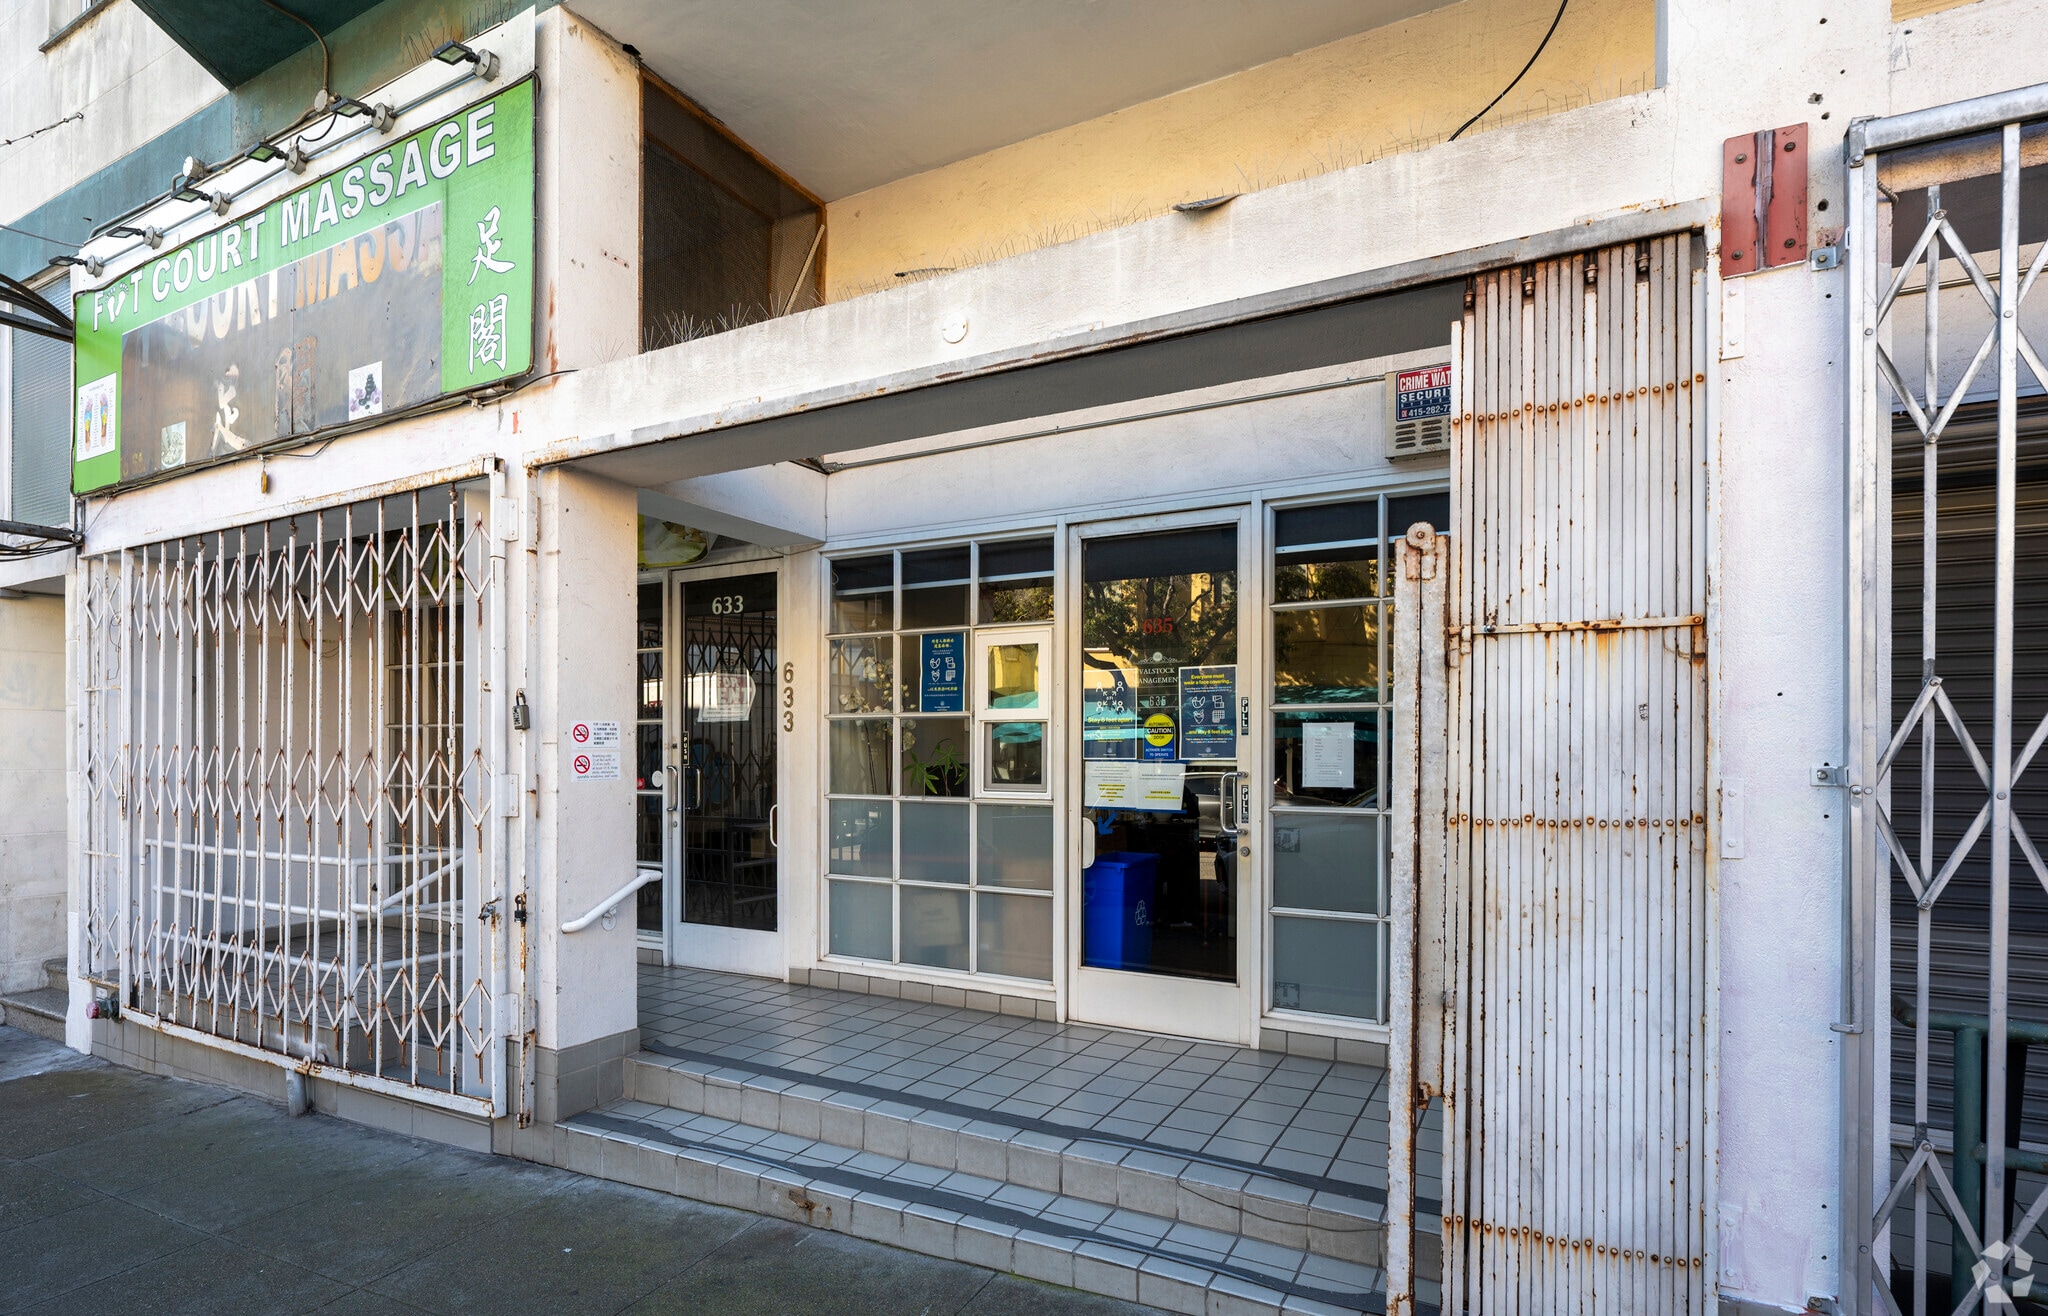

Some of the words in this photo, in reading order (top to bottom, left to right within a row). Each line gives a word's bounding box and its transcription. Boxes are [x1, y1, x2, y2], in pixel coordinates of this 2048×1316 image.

[151, 209, 266, 304] COURT
[280, 102, 497, 248] MASSAGE
[468, 205, 516, 376] 足閣
[1400, 374, 1428, 392] CRIME
[712, 595, 744, 615] 633
[1143, 617, 1174, 634] 635
[783, 661, 794, 733] 633
[1150, 696, 1166, 706] 635
